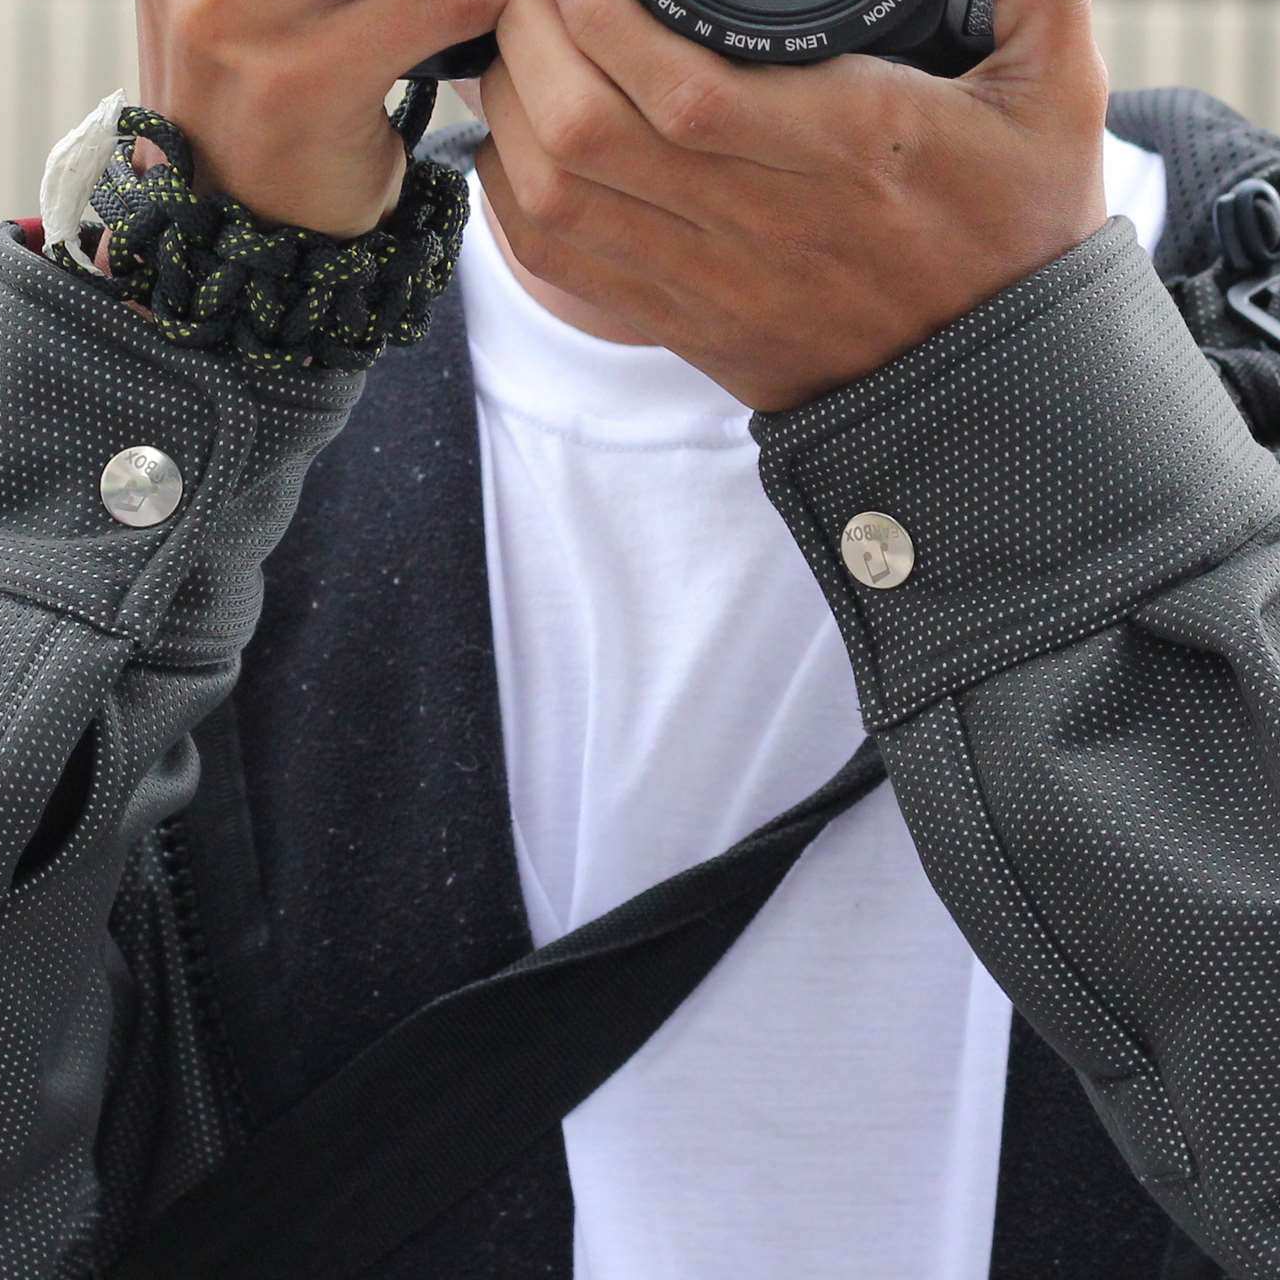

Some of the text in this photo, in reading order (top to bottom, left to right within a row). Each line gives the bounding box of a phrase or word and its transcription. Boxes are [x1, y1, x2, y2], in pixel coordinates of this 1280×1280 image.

[695, 20, 713, 37] IN
[724, 31, 770, 51] MADE
[785, 32, 828, 51] LENS
